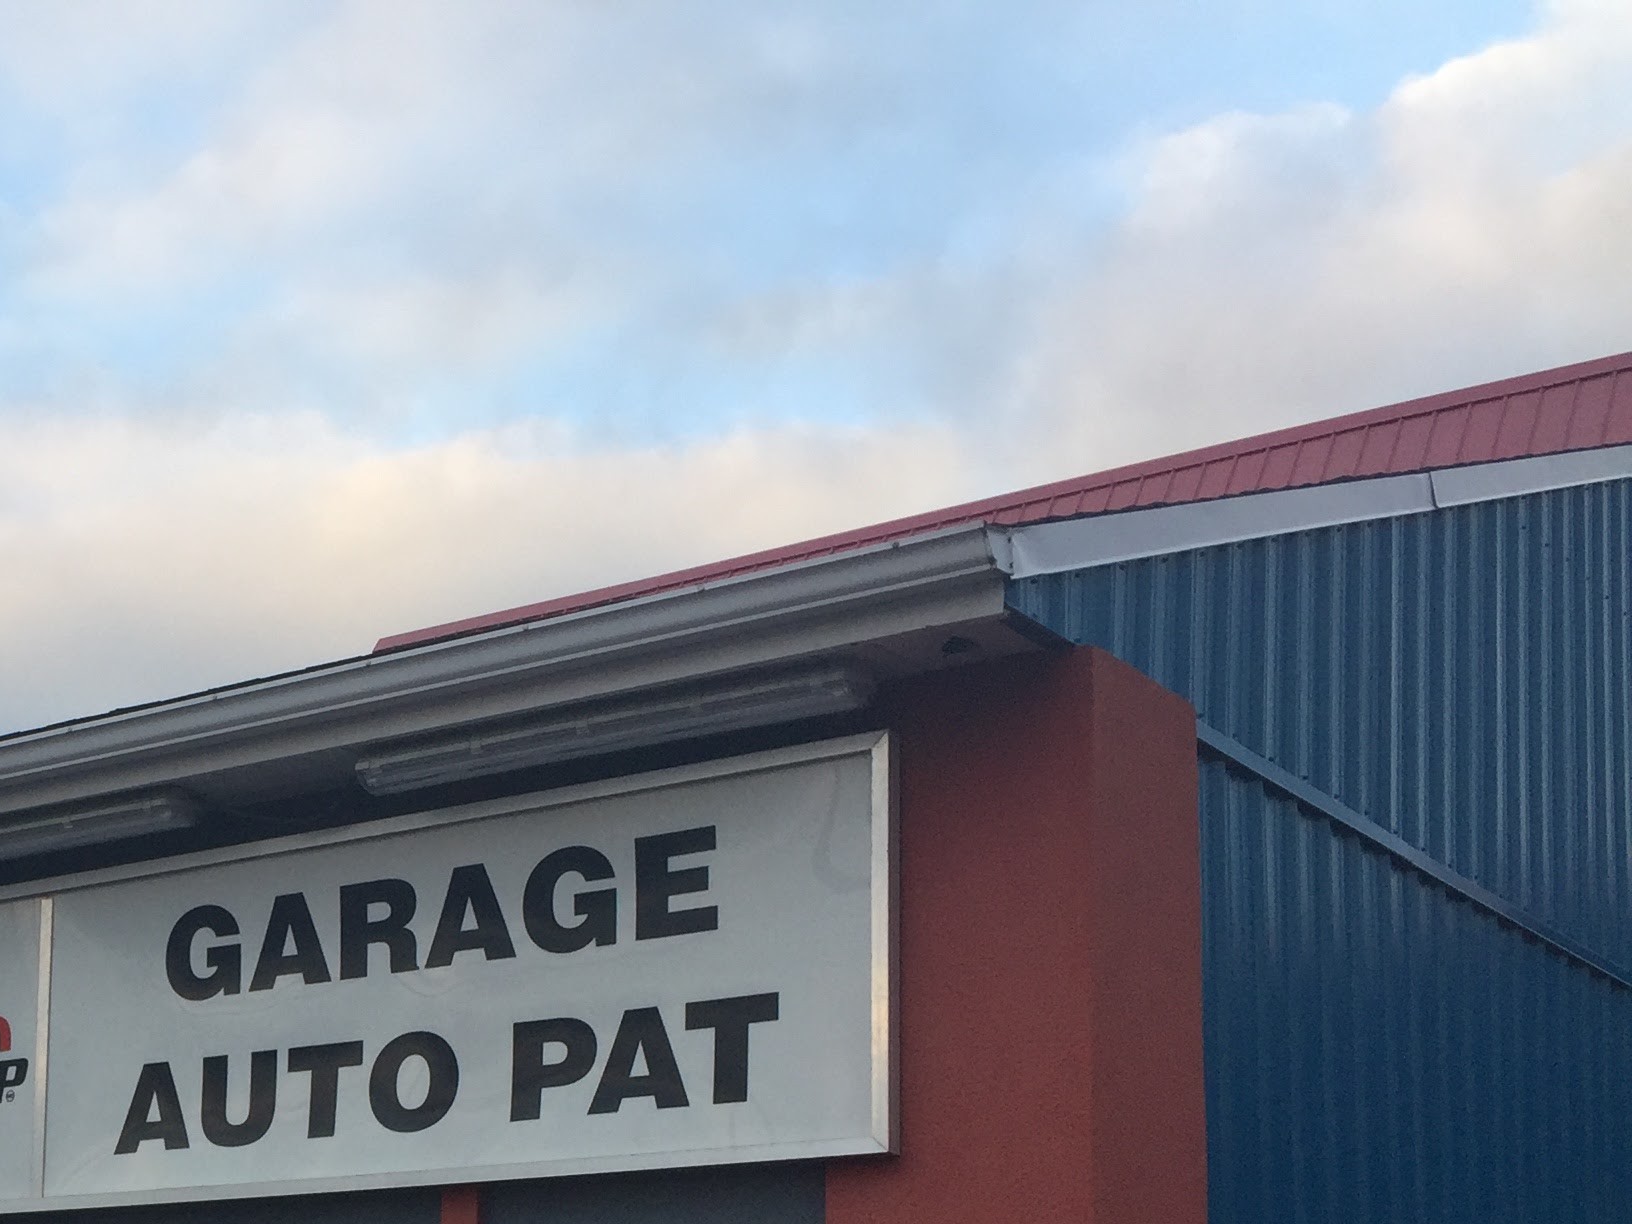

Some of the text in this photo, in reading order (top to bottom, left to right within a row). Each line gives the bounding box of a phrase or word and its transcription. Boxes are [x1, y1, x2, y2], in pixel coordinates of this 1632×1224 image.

[165, 824, 719, 1002] GARAGE
[113, 991, 780, 1156] AUTO PAT
